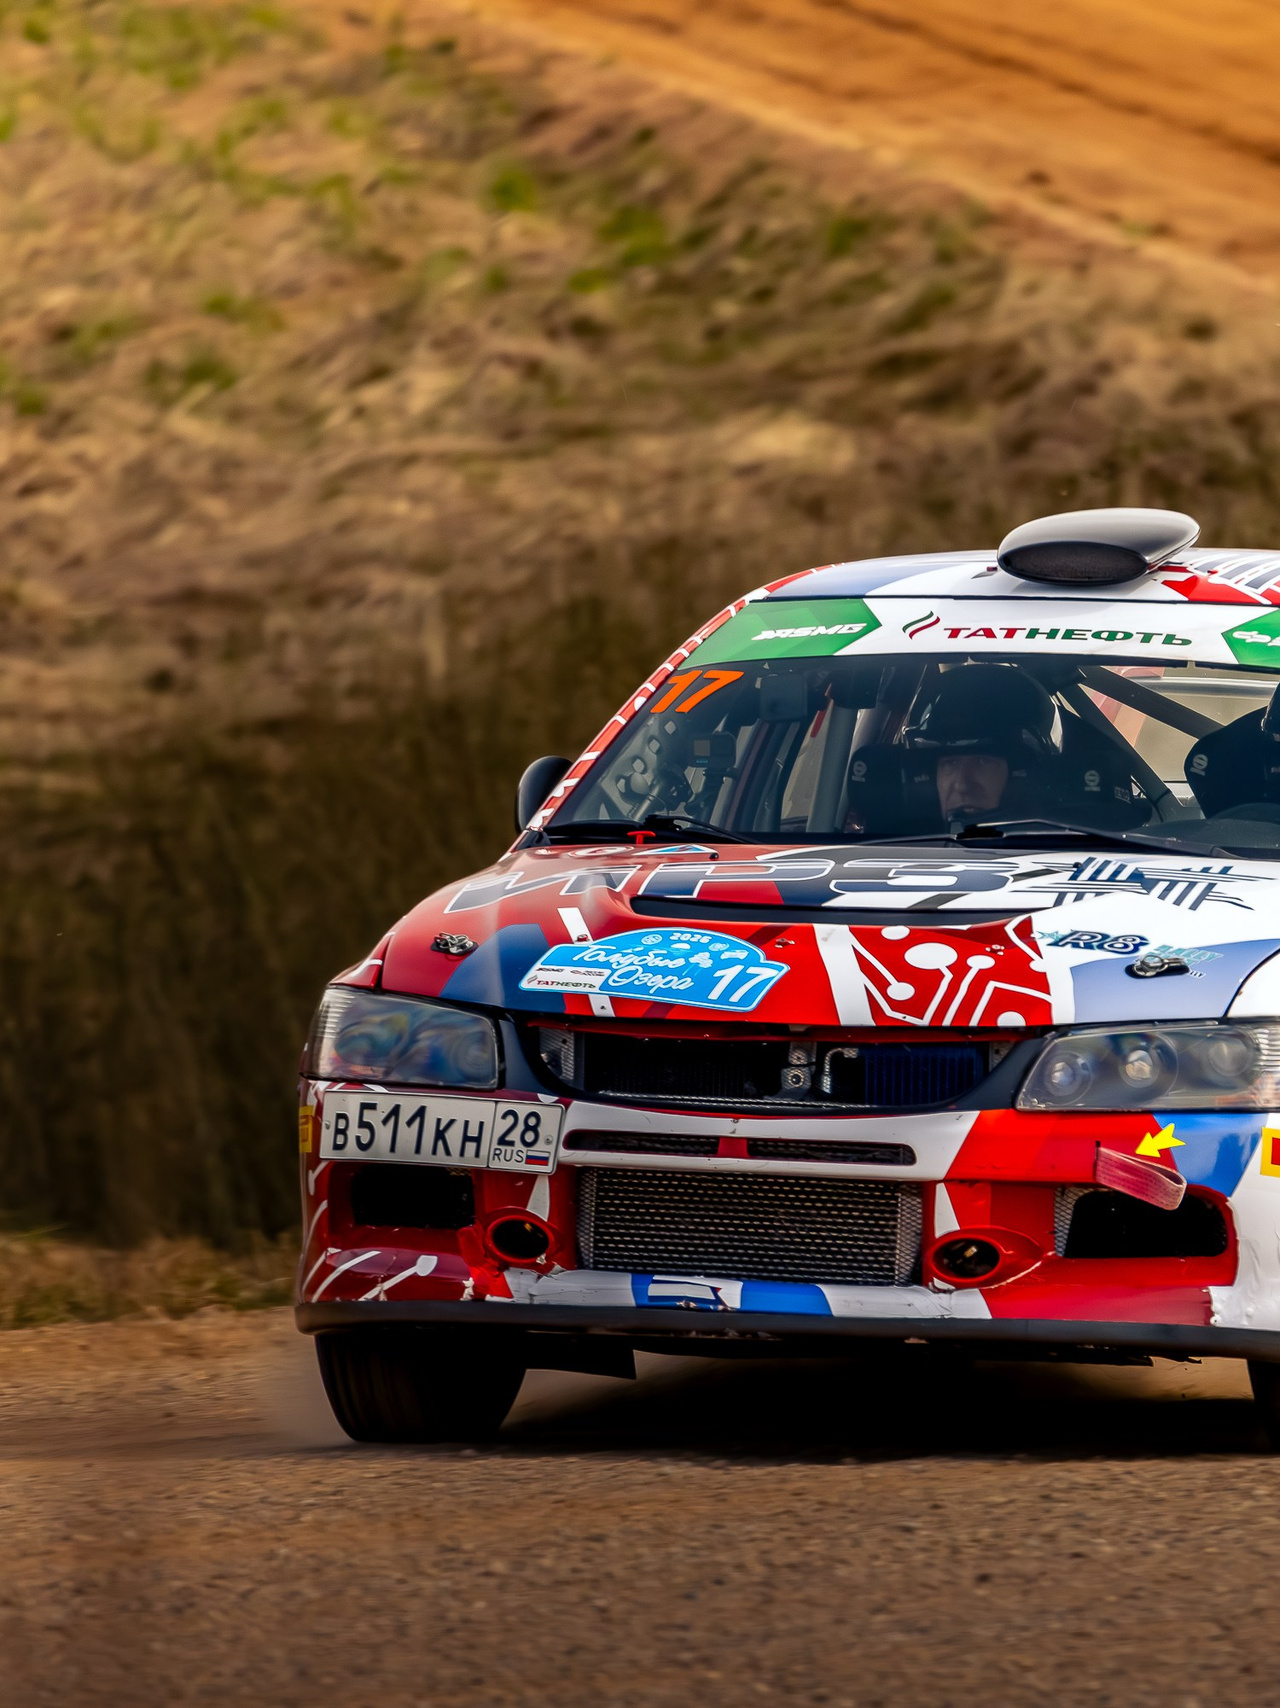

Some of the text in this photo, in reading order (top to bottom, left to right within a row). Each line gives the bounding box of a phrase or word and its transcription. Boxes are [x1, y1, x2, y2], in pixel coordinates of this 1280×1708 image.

[943, 627, 1193, 647] ТАТНЕФТЬ
[650, 670, 744, 713] 17
[707, 964, 779, 1003] 17
[497, 1109, 542, 1149] 28
[492, 1148, 524, 1164] RUS
